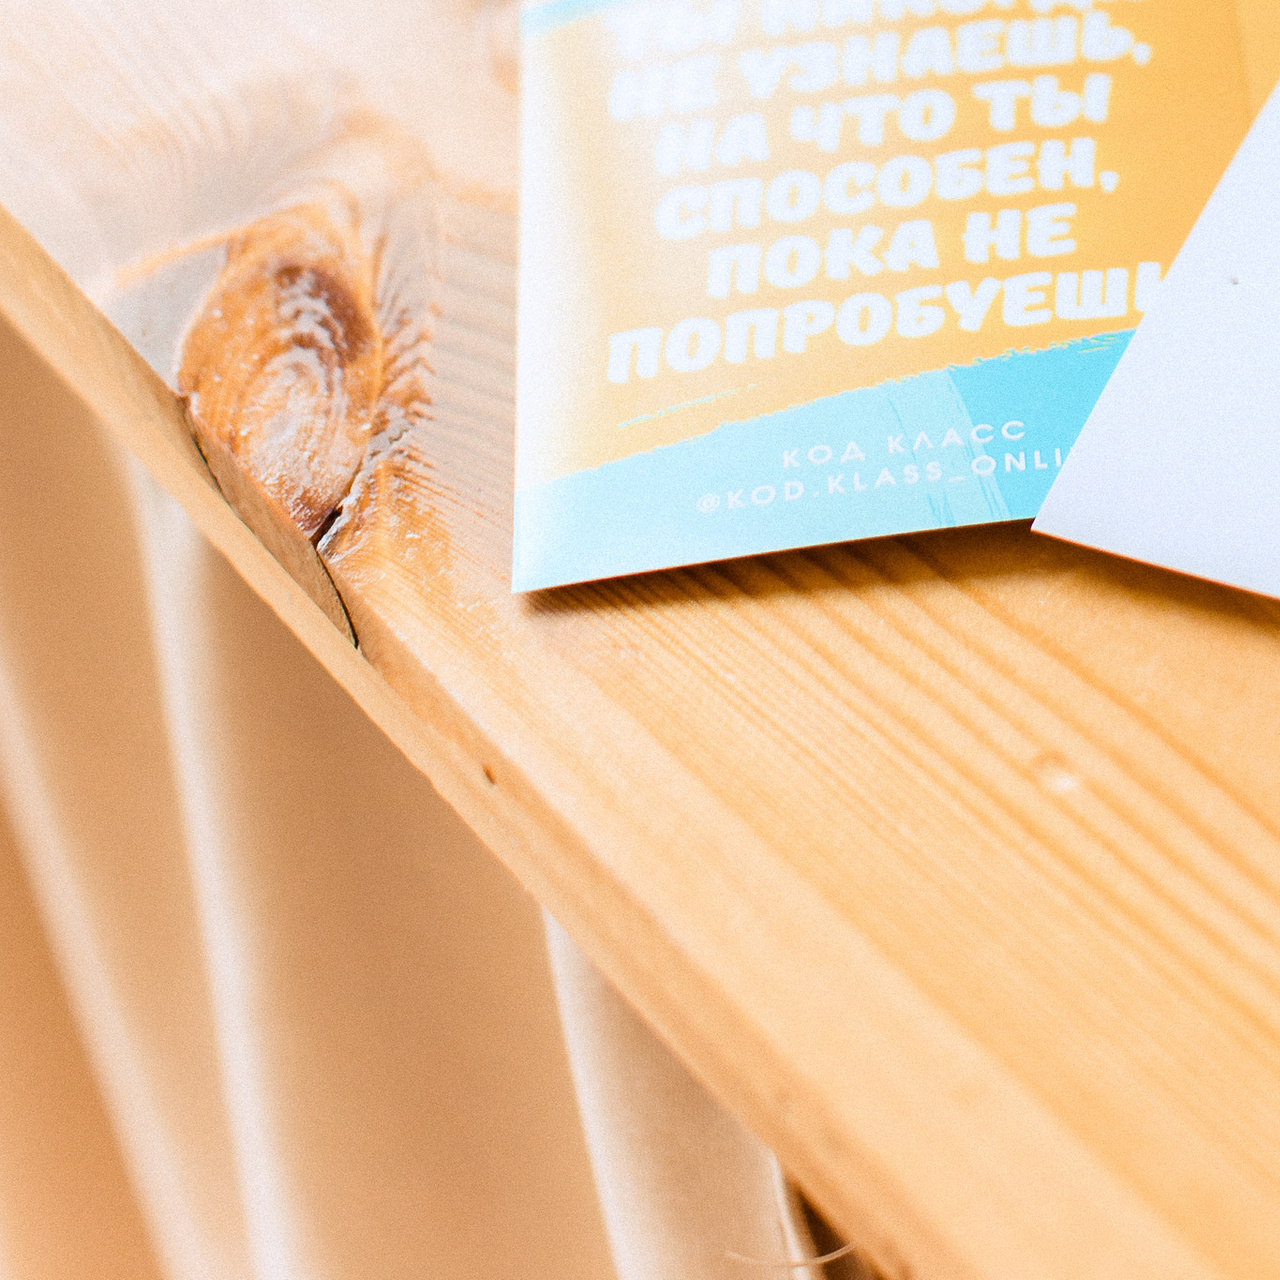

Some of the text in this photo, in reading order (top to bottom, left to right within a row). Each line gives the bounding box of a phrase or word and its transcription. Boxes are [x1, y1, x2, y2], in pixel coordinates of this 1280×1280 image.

[608, 10, 1154, 122] НЕ УЗНАЕШЬ,
[653, 73, 1113, 177] НА ЧТО ТЫ
[654, 137, 1121, 242] СПОСОБЕН,
[706, 203, 1078, 300] ПОКА НЕ
[696, 446, 1071, 515] @KOD.KLASS_ONLI
[782, 420, 1027, 471] КОД КЛАСС
